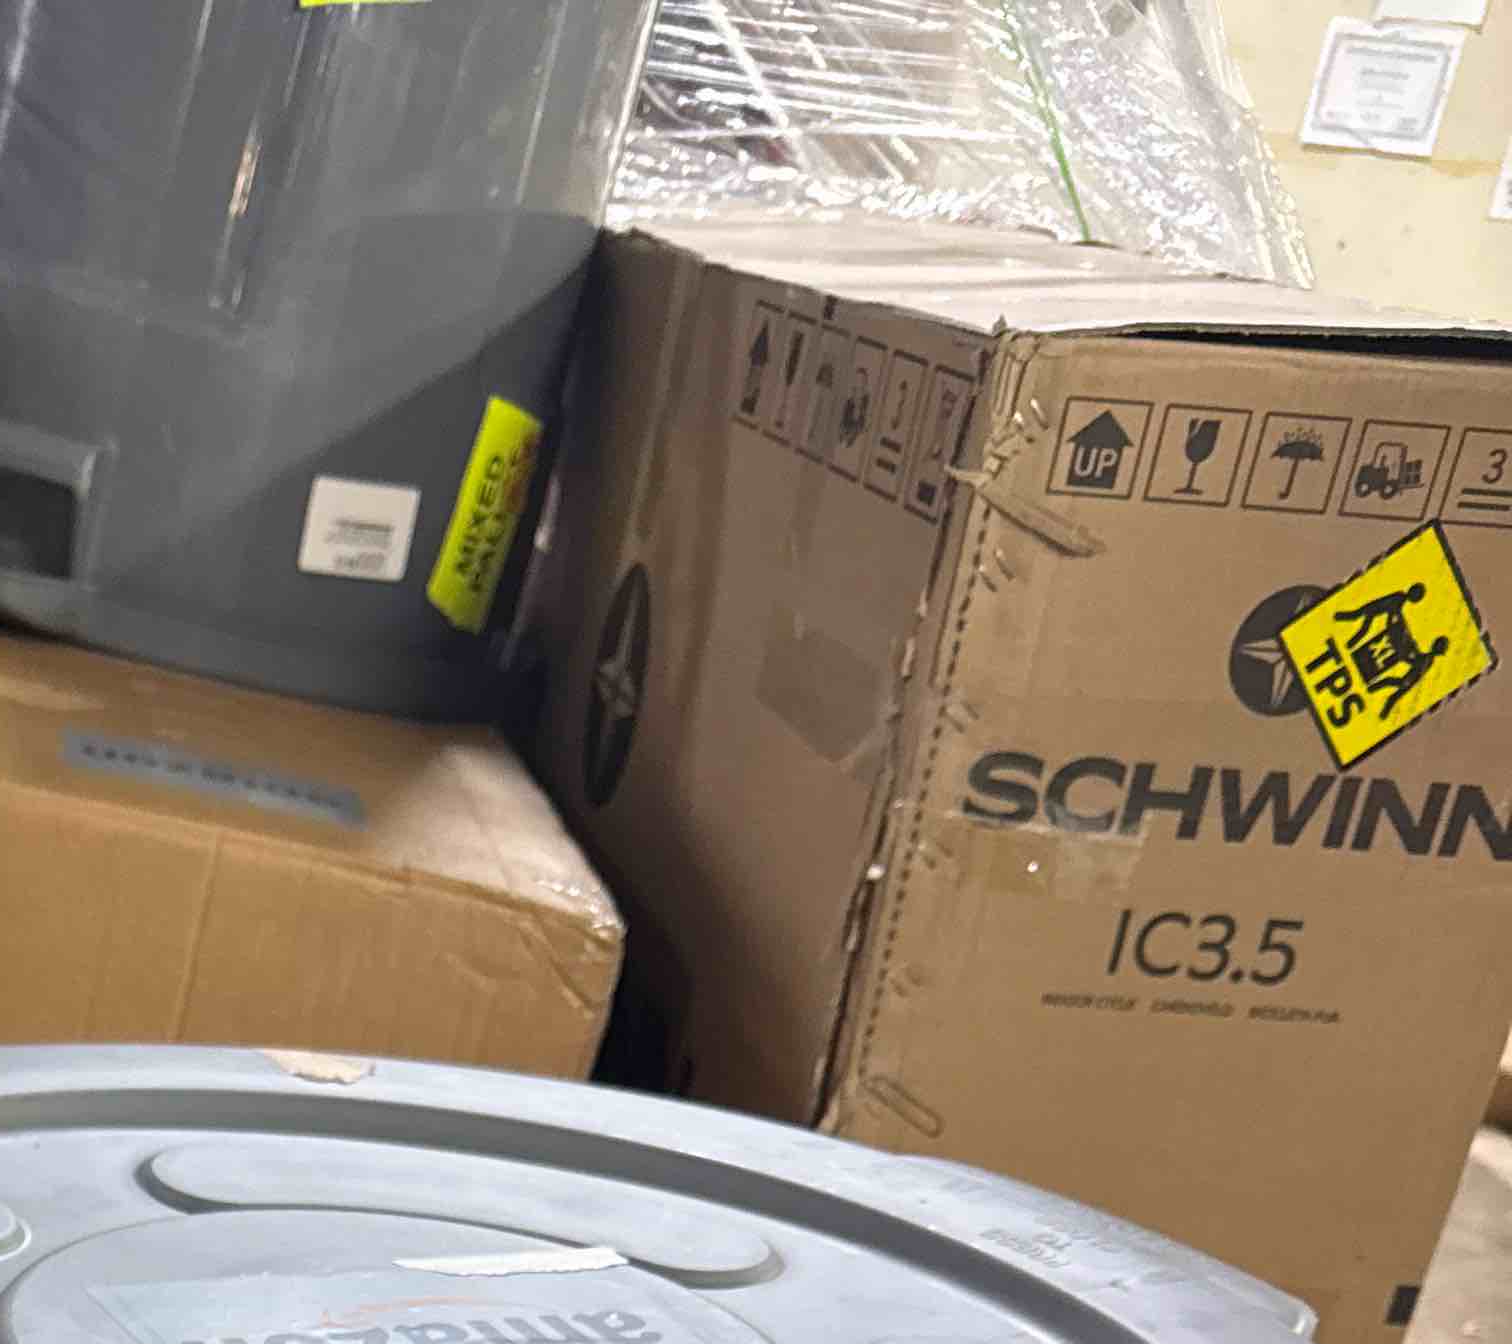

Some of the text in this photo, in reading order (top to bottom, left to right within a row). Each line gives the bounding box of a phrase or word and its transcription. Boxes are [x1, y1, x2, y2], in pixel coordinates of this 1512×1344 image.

[1074, 447, 1119, 479] UP
[1481, 448, 1507, 484] 3
[1305, 637, 1365, 728] TPS
[960, 750, 1512, 862] SCHWINN
[1105, 908, 1306, 986] IC3.5
